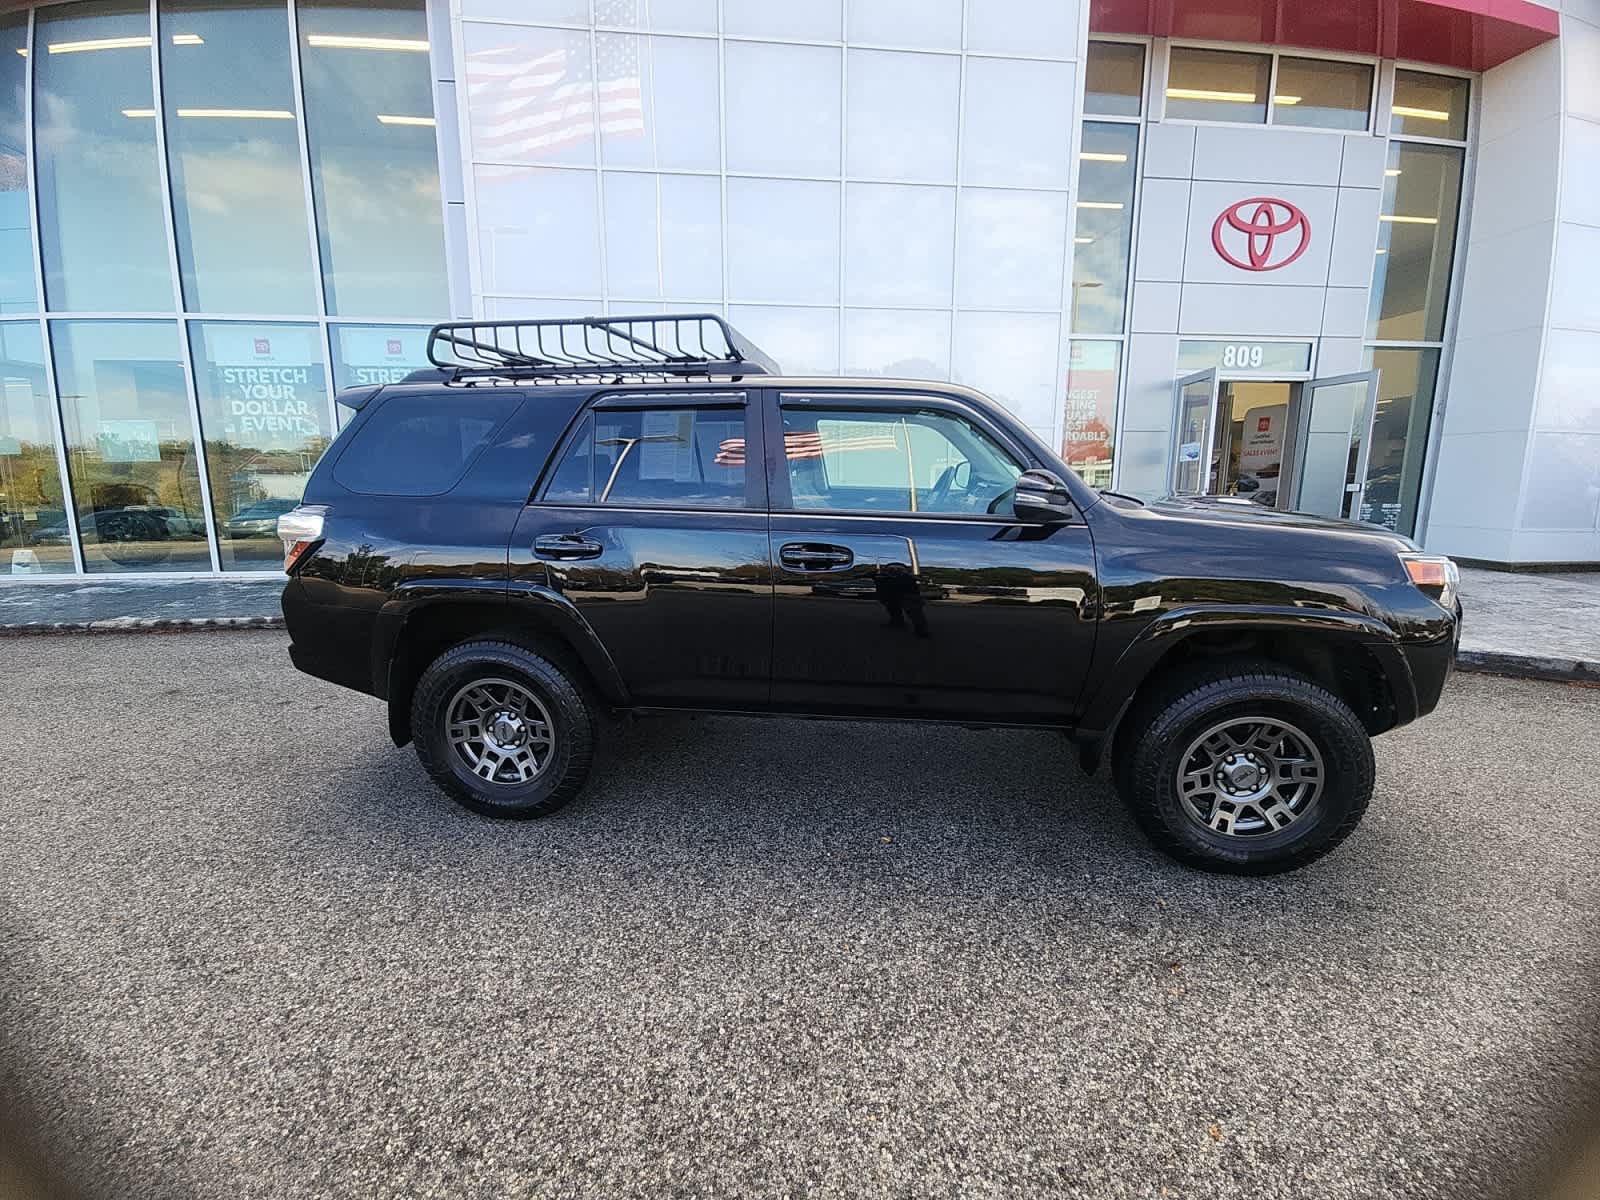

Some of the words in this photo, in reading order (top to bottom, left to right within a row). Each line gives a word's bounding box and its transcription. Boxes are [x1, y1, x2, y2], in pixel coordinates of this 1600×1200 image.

[1223, 345, 1263, 368] 809
[224, 368, 307, 384] STRETCH
[240, 384, 297, 400] YOUR
[231, 400, 309, 416] DOLLAR
[241, 416, 304, 432] EVENT
